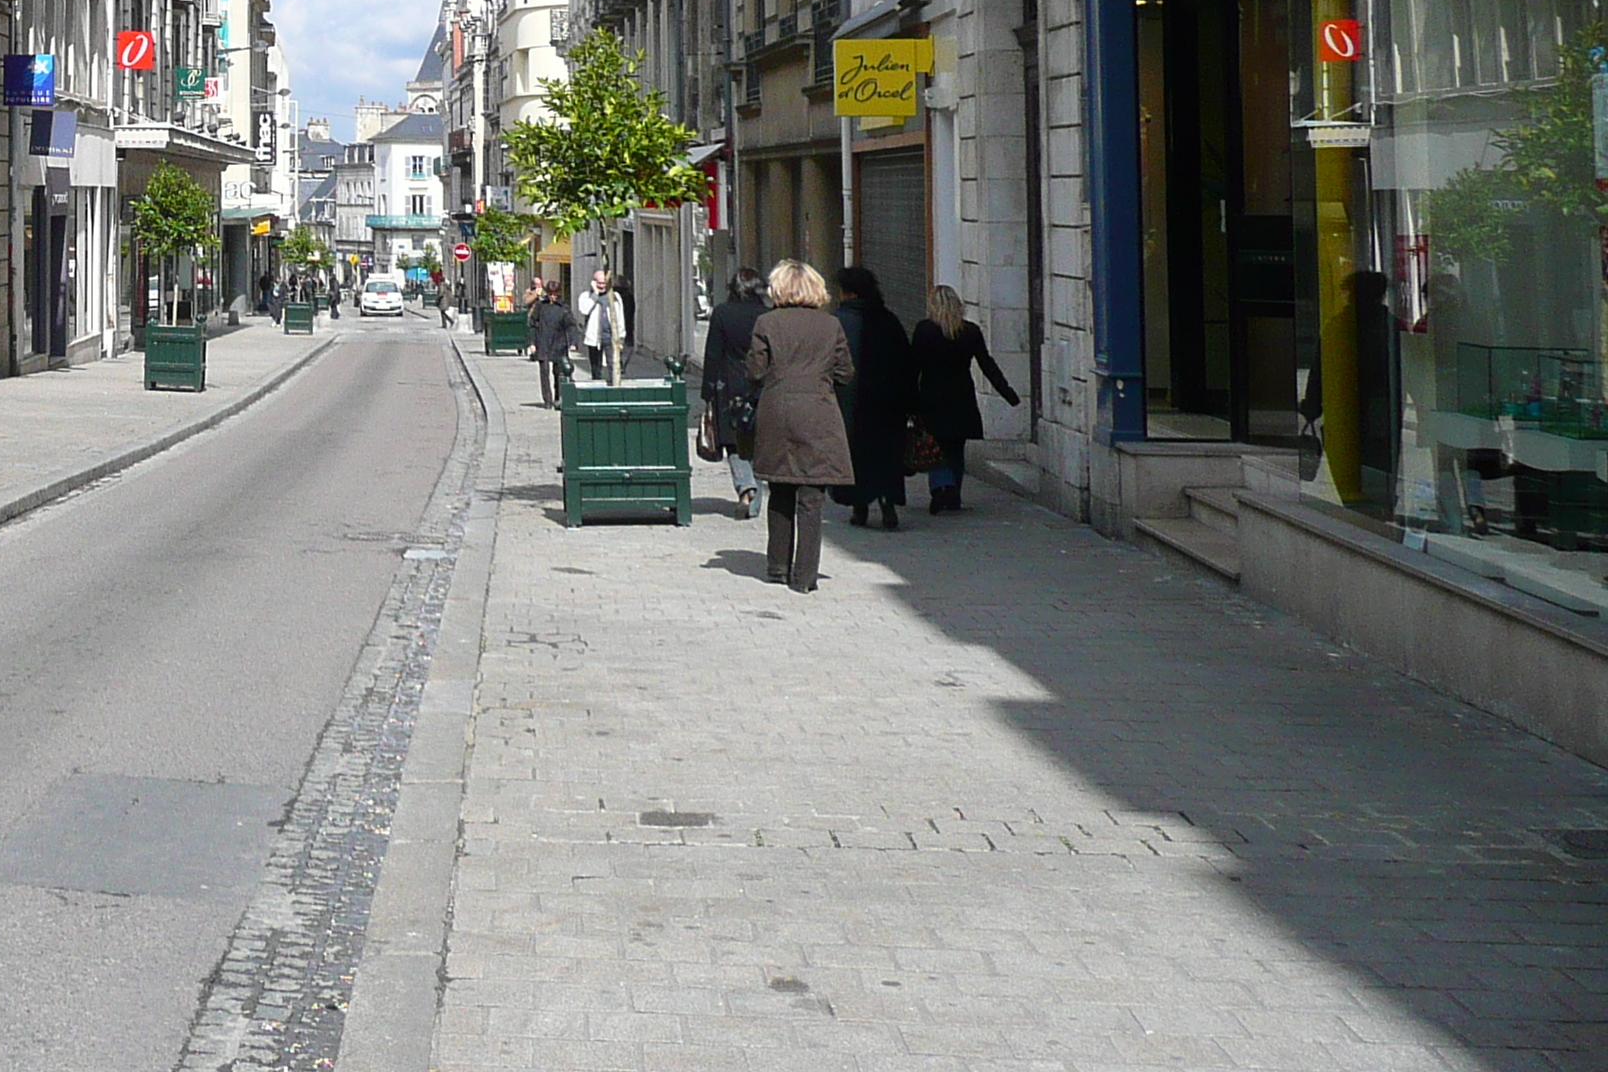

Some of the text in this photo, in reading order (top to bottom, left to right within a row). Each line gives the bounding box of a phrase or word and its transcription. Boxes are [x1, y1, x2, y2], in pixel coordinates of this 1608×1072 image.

[840, 53, 910, 85] Julien
[838, 78, 913, 102] d'Orcel
[255, 113, 272, 161] fnac
